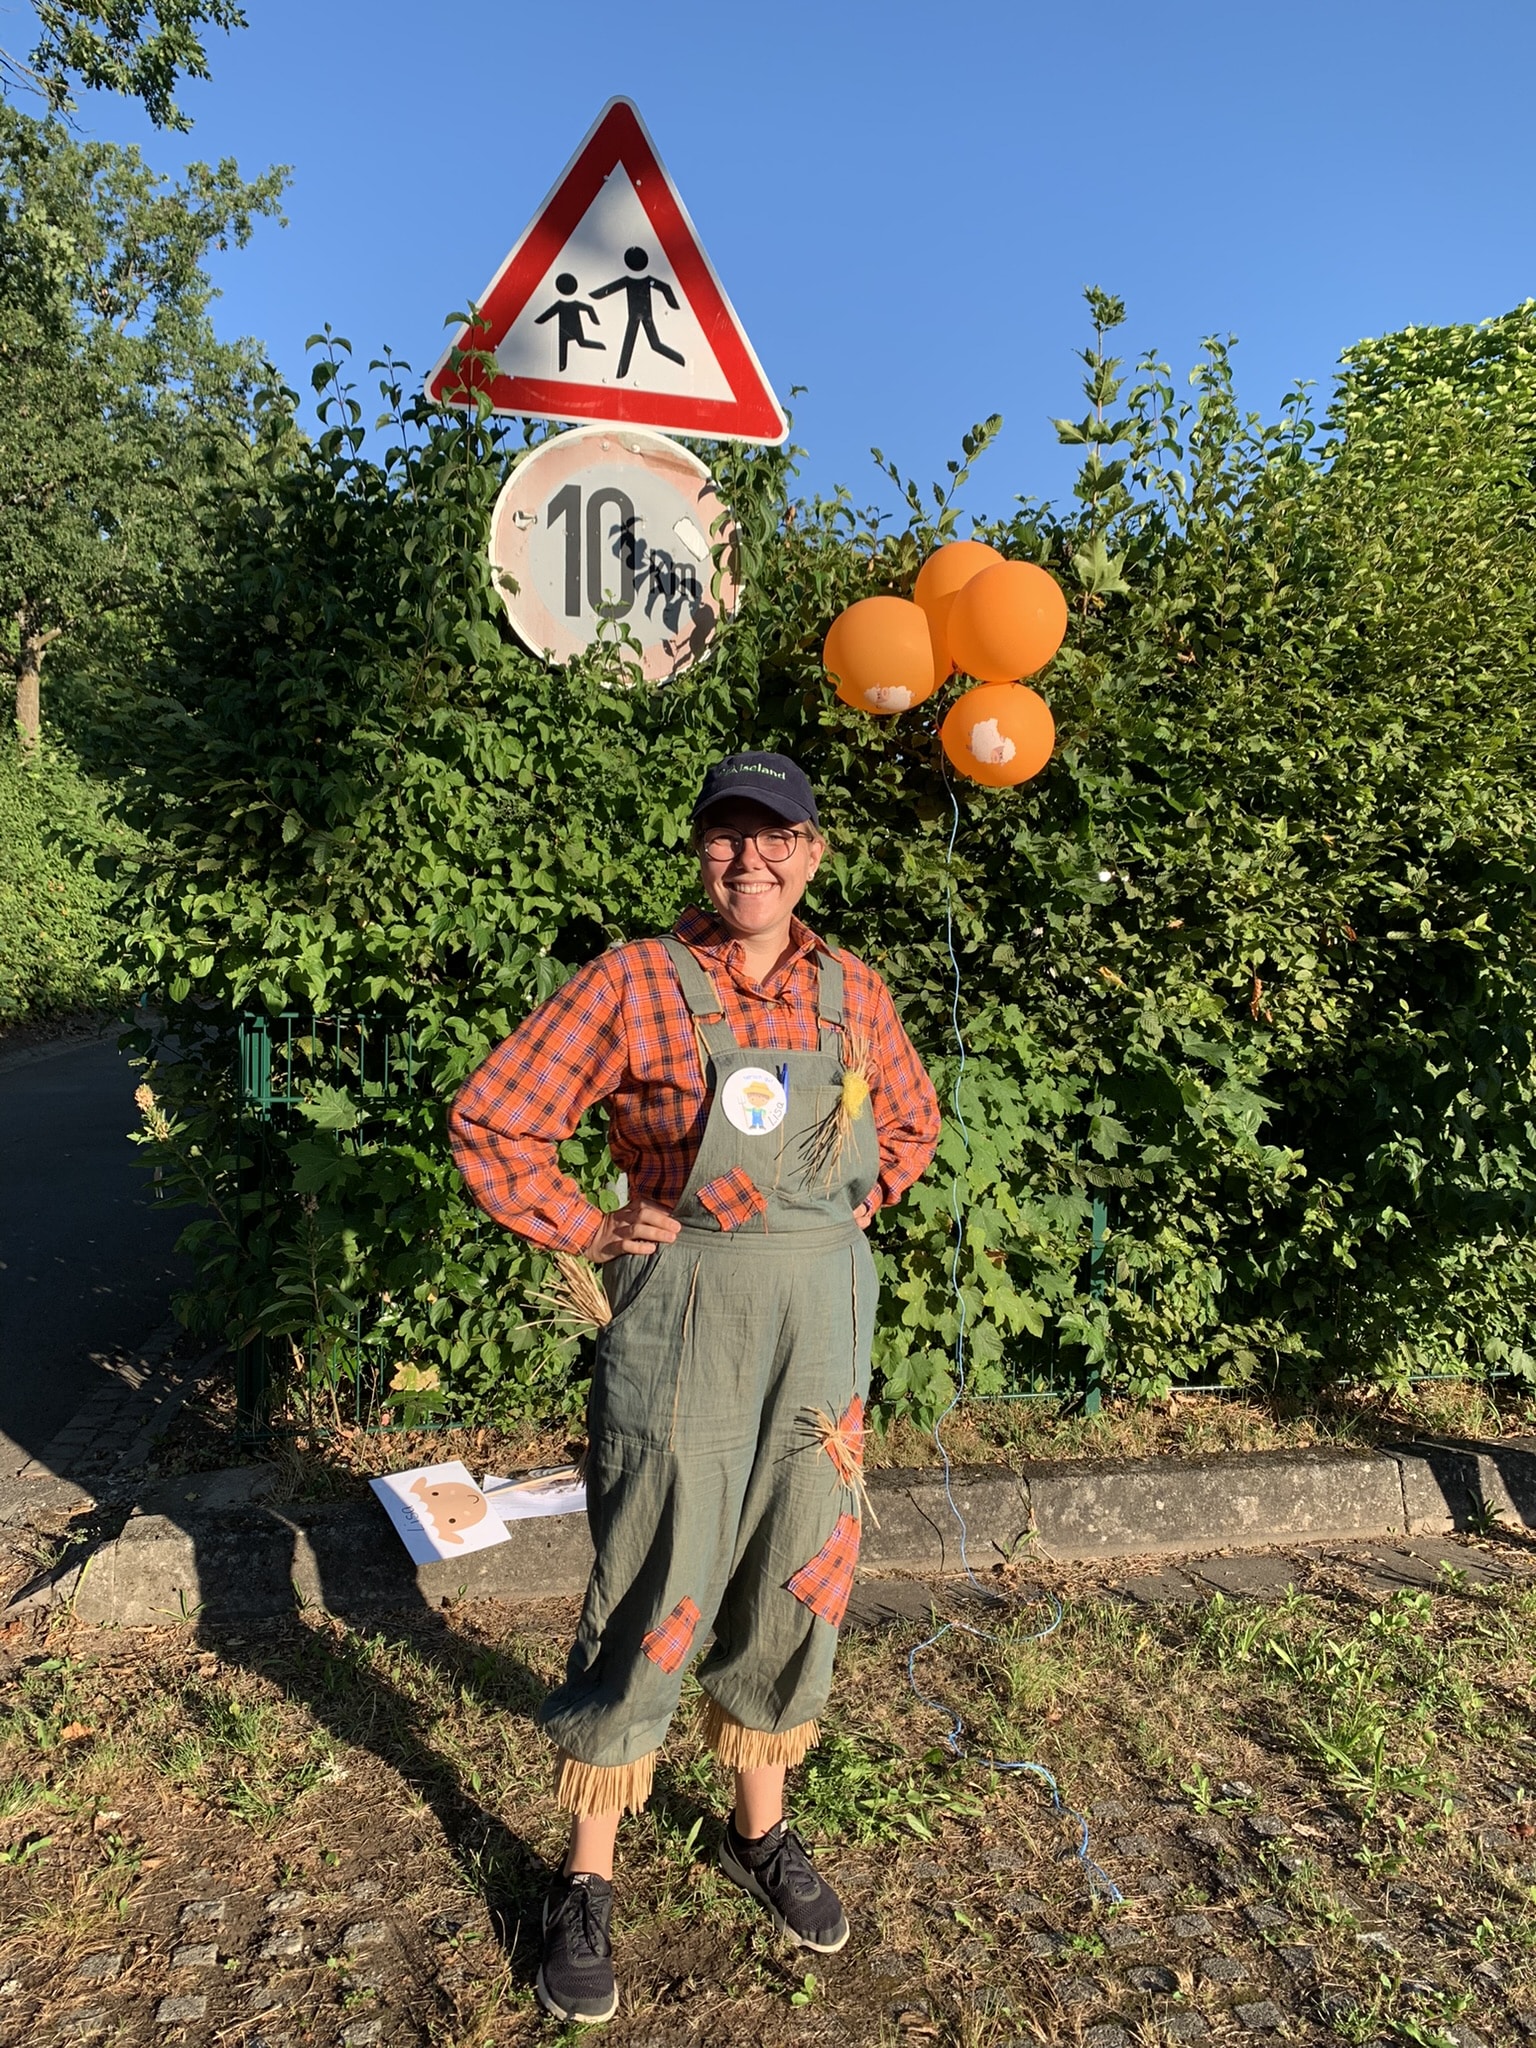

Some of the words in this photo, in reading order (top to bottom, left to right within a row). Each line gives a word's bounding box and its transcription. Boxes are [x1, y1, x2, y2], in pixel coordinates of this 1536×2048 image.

[546, 484, 636, 620] 10
[767, 1102, 785, 1126] Lisa
[401, 1504, 425, 1532] Lisa
